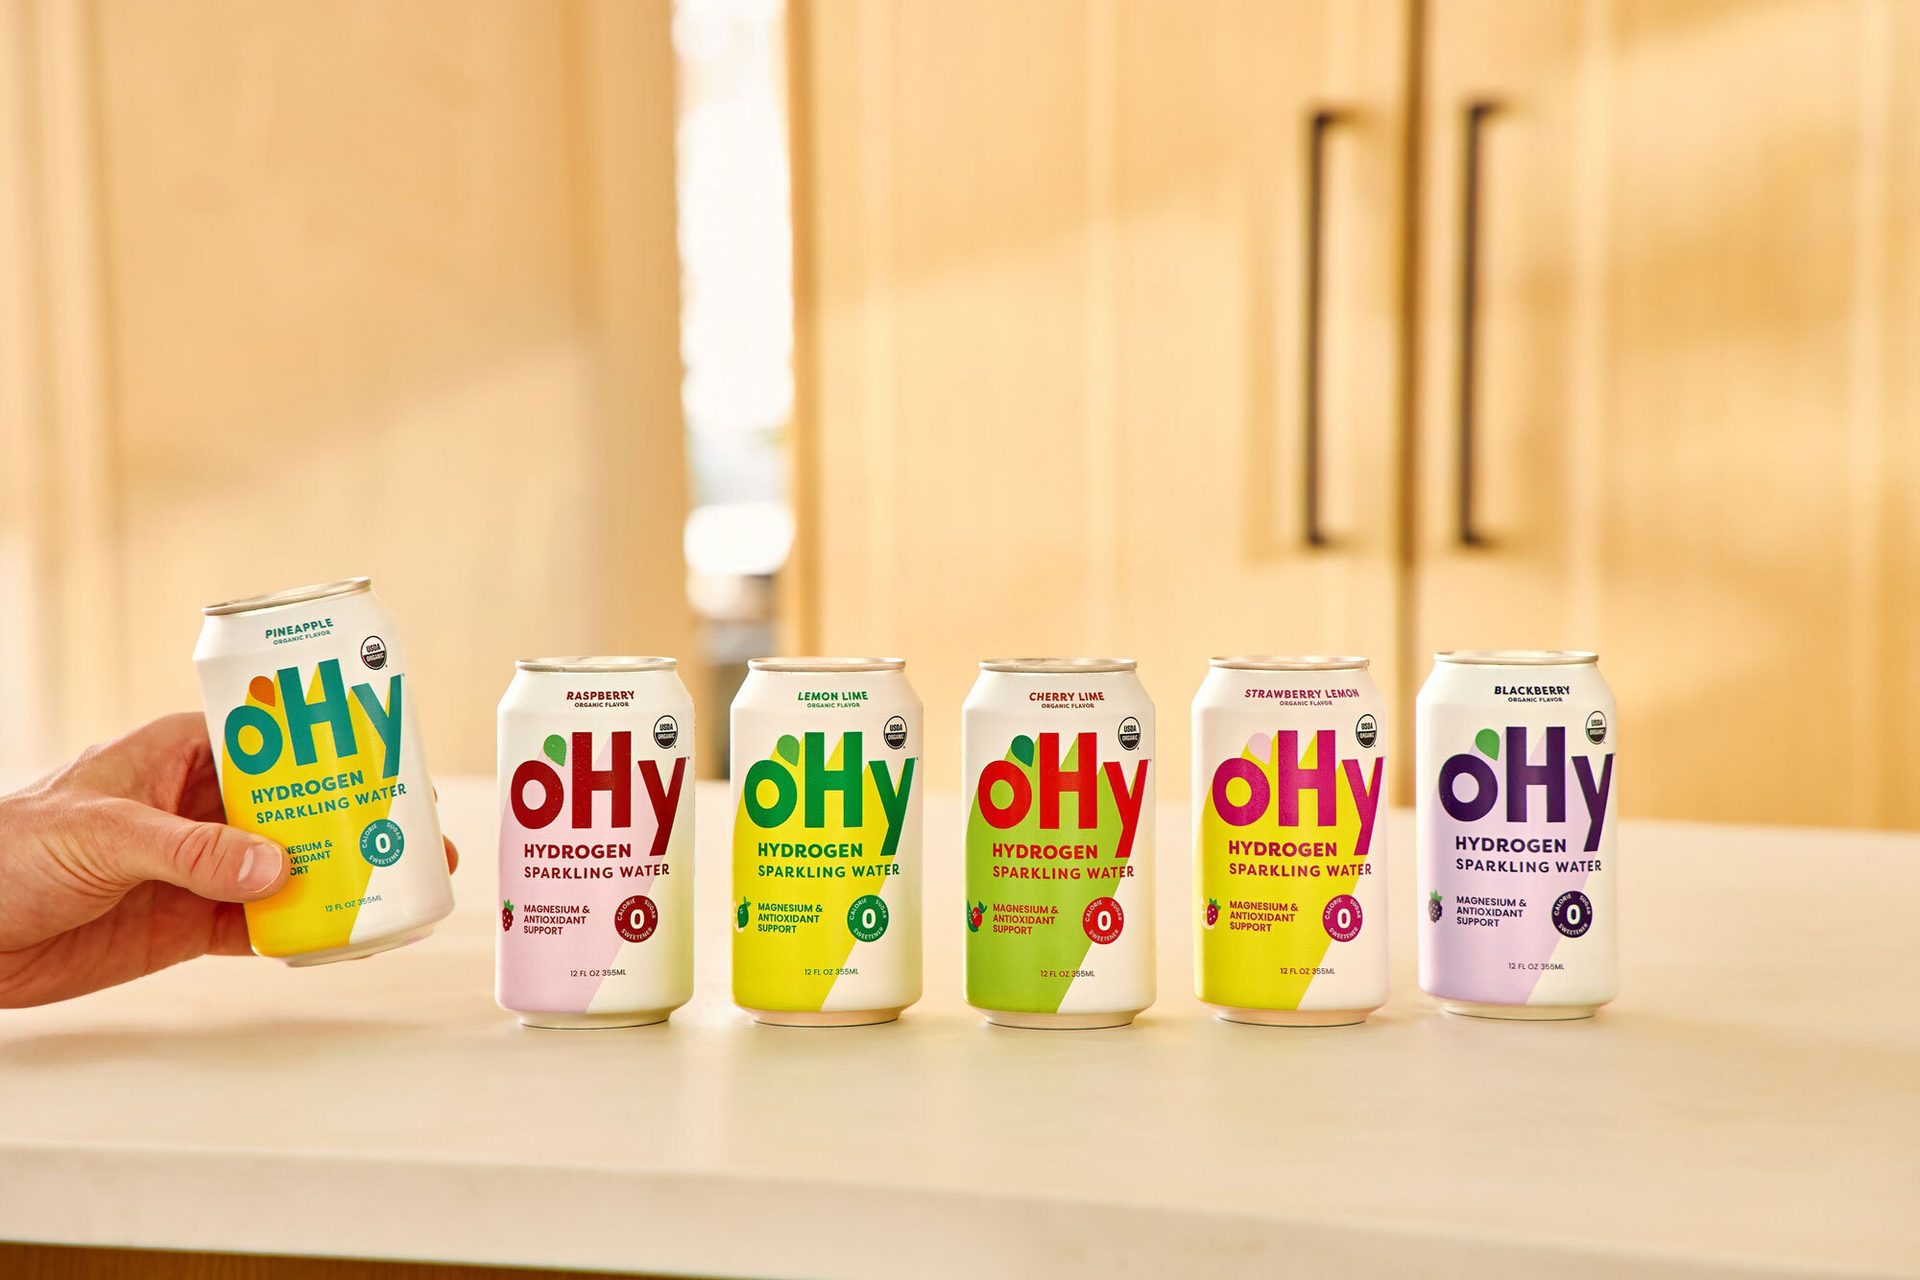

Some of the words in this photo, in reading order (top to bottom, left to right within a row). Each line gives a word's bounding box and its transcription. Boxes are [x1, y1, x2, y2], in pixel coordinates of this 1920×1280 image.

[265, 618, 334, 639] PINEAPPLE
[273, 635, 304, 645] ORGANIC
[305, 630, 331, 639] FLAVOR
[366, 643, 380, 652] USDA
[366, 652, 384, 661] ORGANIC
[567, 691, 634, 700] RASPBERRY
[798, 692, 838, 701] LEMON
[842, 691, 868, 700] LIME
[1029, 692, 1075, 701] CHERRY
[1079, 692, 1104, 701] LIME
[1244, 689, 1322, 698] STRAWBERRY
[1325, 689, 1360, 698] LEMON
[1494, 686, 1570, 695] BLACKBERRY
[252, 770, 364, 804] HYDROGEN
[256, 798, 349, 824] SPARKLING
[355, 783, 406, 805] WATER
[362, 823, 377, 848] CALORIE
[386, 822, 402, 840] SUGAR
[286, 841, 322, 854] NESIUM
[324, 840, 332, 848] &
[375, 833, 391, 853] 0
[1229, 840, 1336, 857] HYDROGEN
[1455, 836, 1566, 853] HYDROGEN
[290, 850, 331, 864] XIDANT
[368, 848, 400, 864] SWEETENER
[524, 844, 631, 859] HYDROGEN
[758, 843, 863, 858] HYDROGEN
[992, 843, 1098, 859] HYDROGEN
[524, 866, 613, 879] SPARKLING
[620, 864, 669, 877] WATER
[758, 865, 845, 878] SPARKLING
[852, 864, 900, 877] WATER
[993, 866, 1080, 879] SPARKLING
[1087, 866, 1134, 878] WATER
[1229, 863, 1320, 877] SPARKLING
[1327, 864, 1372, 876] WATER
[1456, 858, 1549, 873] SPARKLING
[1555, 860, 1602, 872] WATER
[345, 900, 356, 909] OZ
[358, 895, 382, 906] 355ML
[758, 903, 812, 912] MAGNESIUM
[1229, 901, 1288, 911] MAGNESIUM
[1290, 903, 1298, 911] &
[1350, 899, 1361, 918] SUGAR
[1456, 896, 1516, 907] MAGNESIUM
[1554, 894, 1572, 916] CALORIE
[1579, 895, 1591, 915] SUGAR
[524, 905, 579, 914] MAGNESIUM
[617, 898, 636, 921] CALORIE
[644, 900, 656, 919] SUGAR
[850, 898, 867, 920] CALORIE
[875, 899, 887, 919] SUGAR
[993, 904, 1048, 914] MAGNESIUM
[1051, 906, 1059, 914] &
[1085, 900, 1102, 922] CALORIE
[1110, 902, 1122, 921] SUGAR
[1325, 898, 1342, 920] CALORIE
[1456, 908, 1523, 918] ANTIOXIDANT
[1567, 904, 1581, 925] 0
[524, 916, 586, 924] ANTIOXIDANT
[630, 909, 645, 929] 0
[758, 914, 820, 923] ANTIOXIDANT
[862, 908, 876, 928] 0
[993, 915, 1055, 924] ANTIOXIDANT
[1097, 911, 1112, 931] 0
[1229, 912, 1295, 922] ANTIOXIDANT
[1337, 908, 1351, 928] 0
[1457, 917, 1499, 927] SUPPORT
[523, 926, 563, 935] SUPPORT
[621, 928, 653, 940] SWEETENER
[758, 924, 797, 933] SUPPORT
[852, 926, 884, 940] SWEETENER
[993, 925, 1032, 934] SUPPORT
[1230, 922, 1272, 932] SUPPORT
[1328, 926, 1358, 940] SWEETENER
[1558, 923, 1588, 935] SWEETENER
[1089, 929, 1120, 942] SWEETENER
